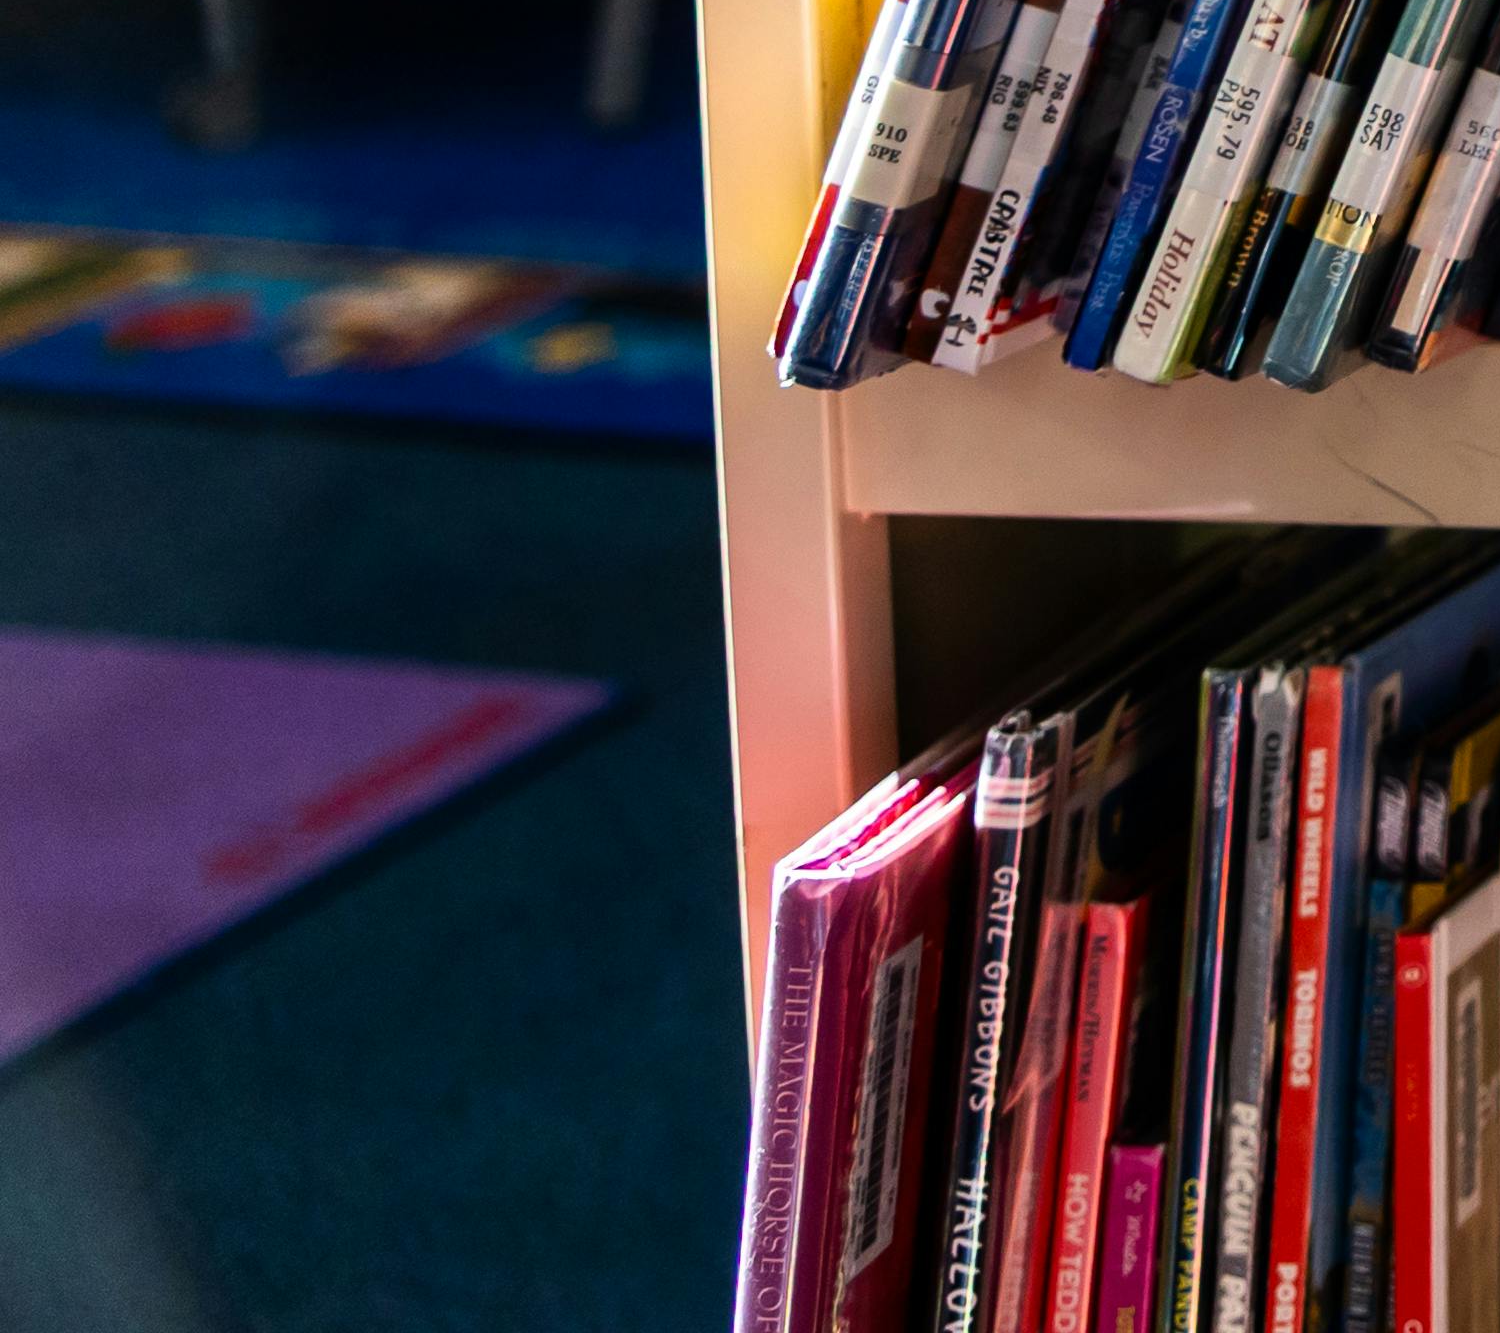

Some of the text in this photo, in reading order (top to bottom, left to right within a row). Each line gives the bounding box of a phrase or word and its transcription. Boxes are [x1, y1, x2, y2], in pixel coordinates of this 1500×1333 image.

[1247, 1, 1287, 51] AT
[858, 74, 880, 106] GIS
[989, 73, 1013, 107] RIG
[1000, 79, 1031, 133] 599.63
[1040, 70, 1072, 127] 796.48
[1211, 78, 1239, 118] PAT
[1214, 84, 1259, 162] 595.79
[960, 185, 1022, 302] CRABTREE
[1129, 227, 1197, 341] Holiday
[1298, 748, 1328, 918] WILD WHEELS
[781, 960, 815, 1030] THE
[970, 866, 1020, 1114] GAIL GIBBONS
[1289, 969, 1318, 1088] TORINOS
[772, 1040, 807, 1150] MAGIC
[757, 1161, 796, 1277] HORSE
[1060, 1174, 1090, 1252] HOW
